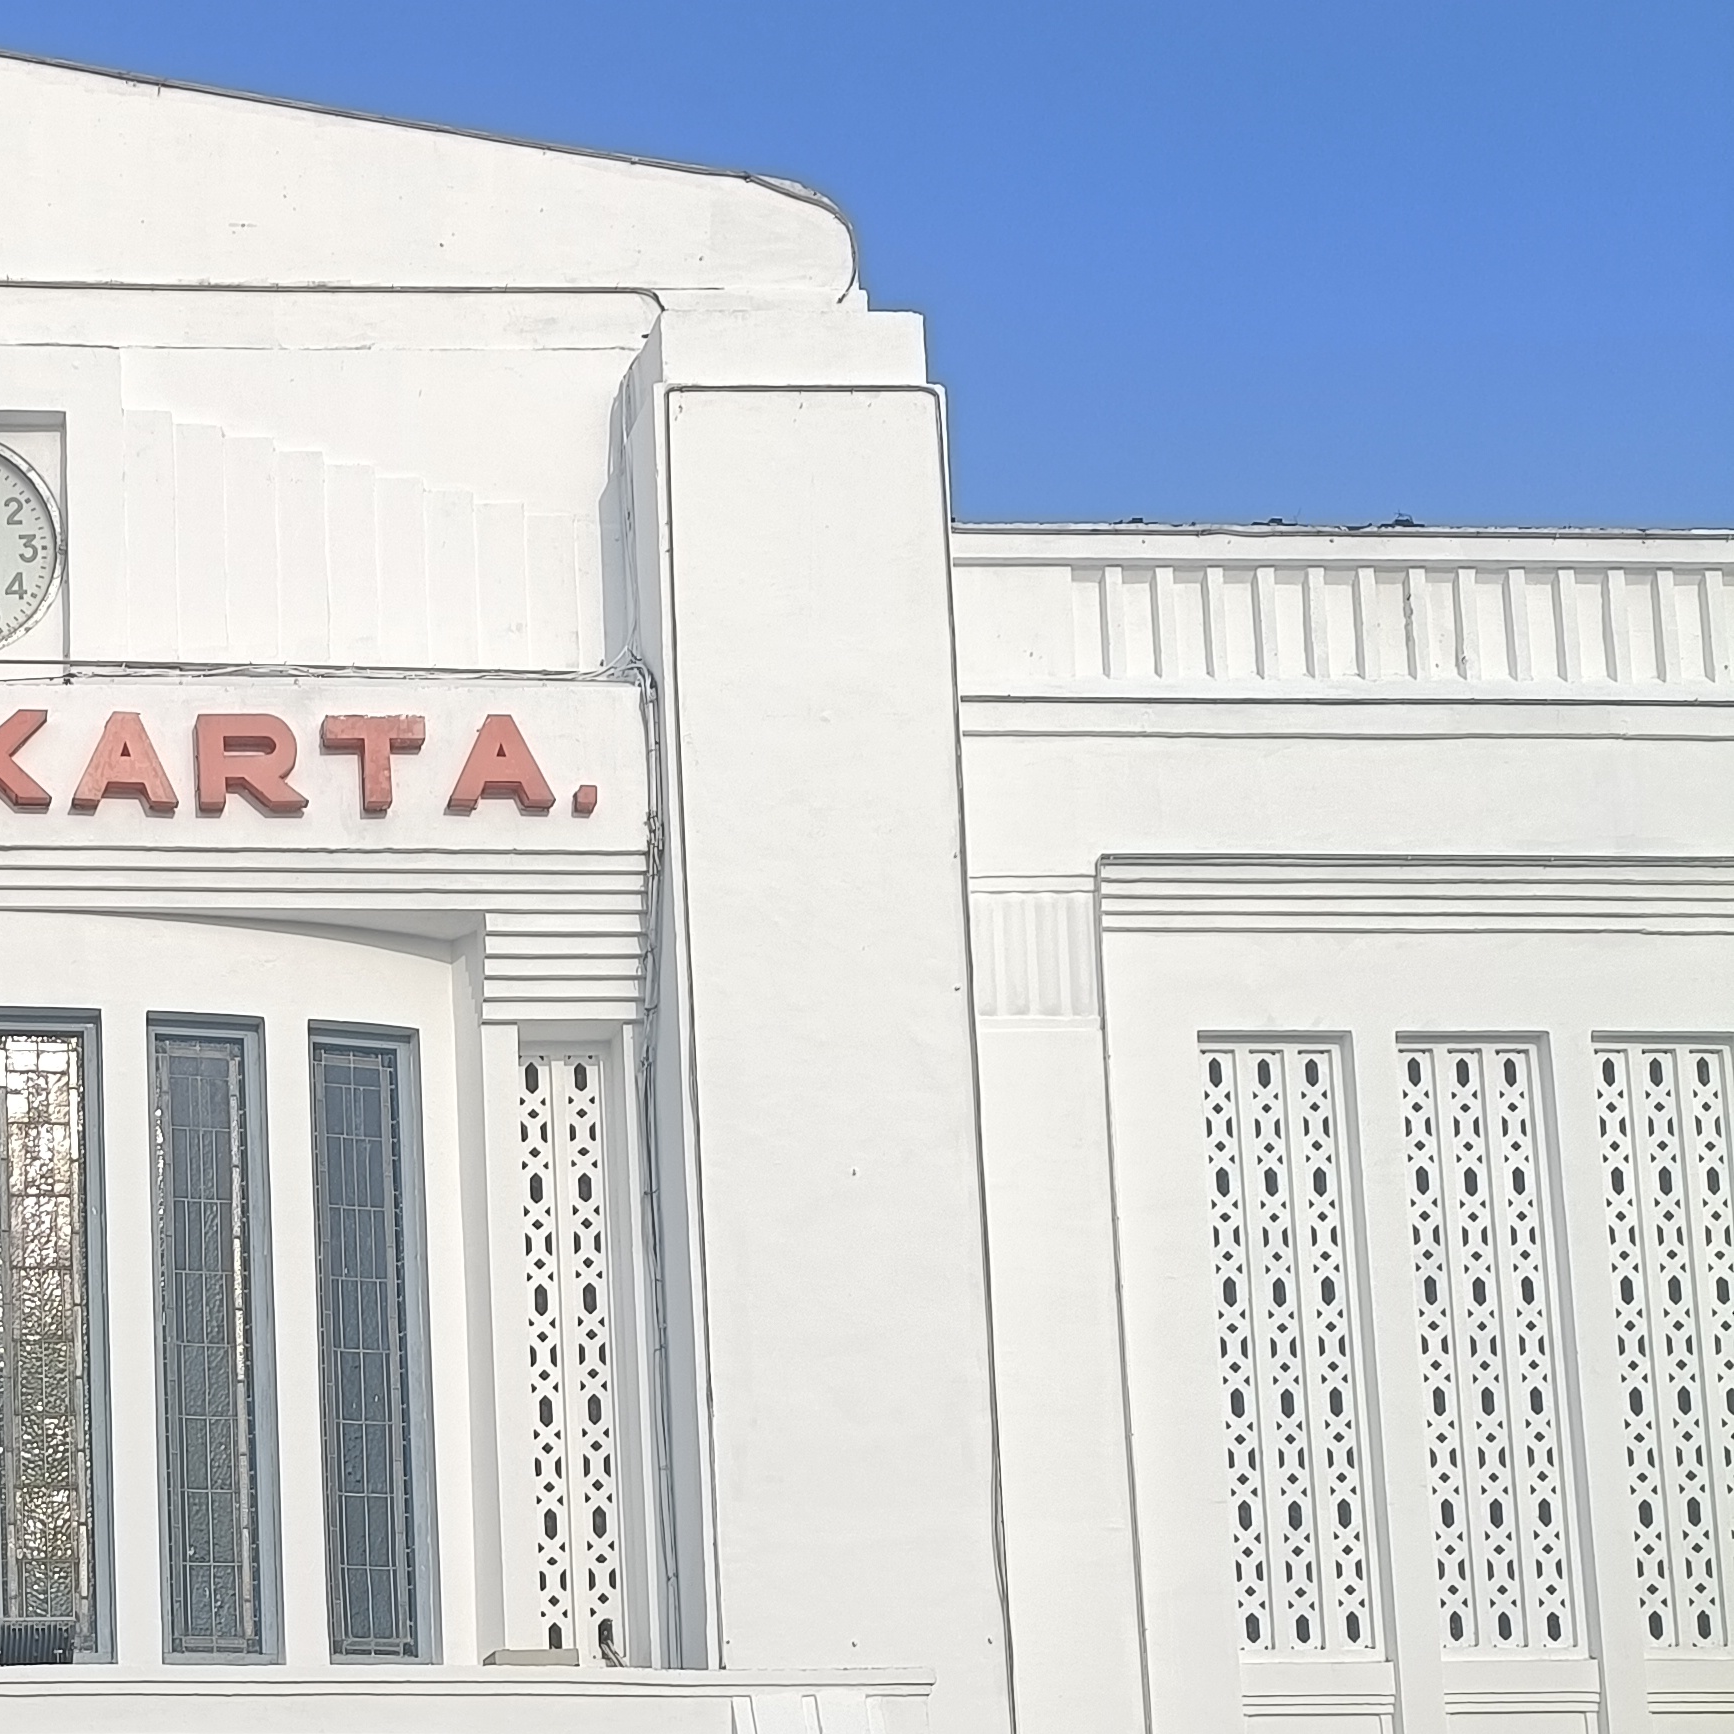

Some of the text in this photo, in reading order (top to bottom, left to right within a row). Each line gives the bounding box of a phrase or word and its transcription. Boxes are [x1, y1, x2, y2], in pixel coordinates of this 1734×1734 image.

[4, 497, 23, 525] 2
[18, 534, 38, 563] 3
[5, 572, 27, 600] 4
